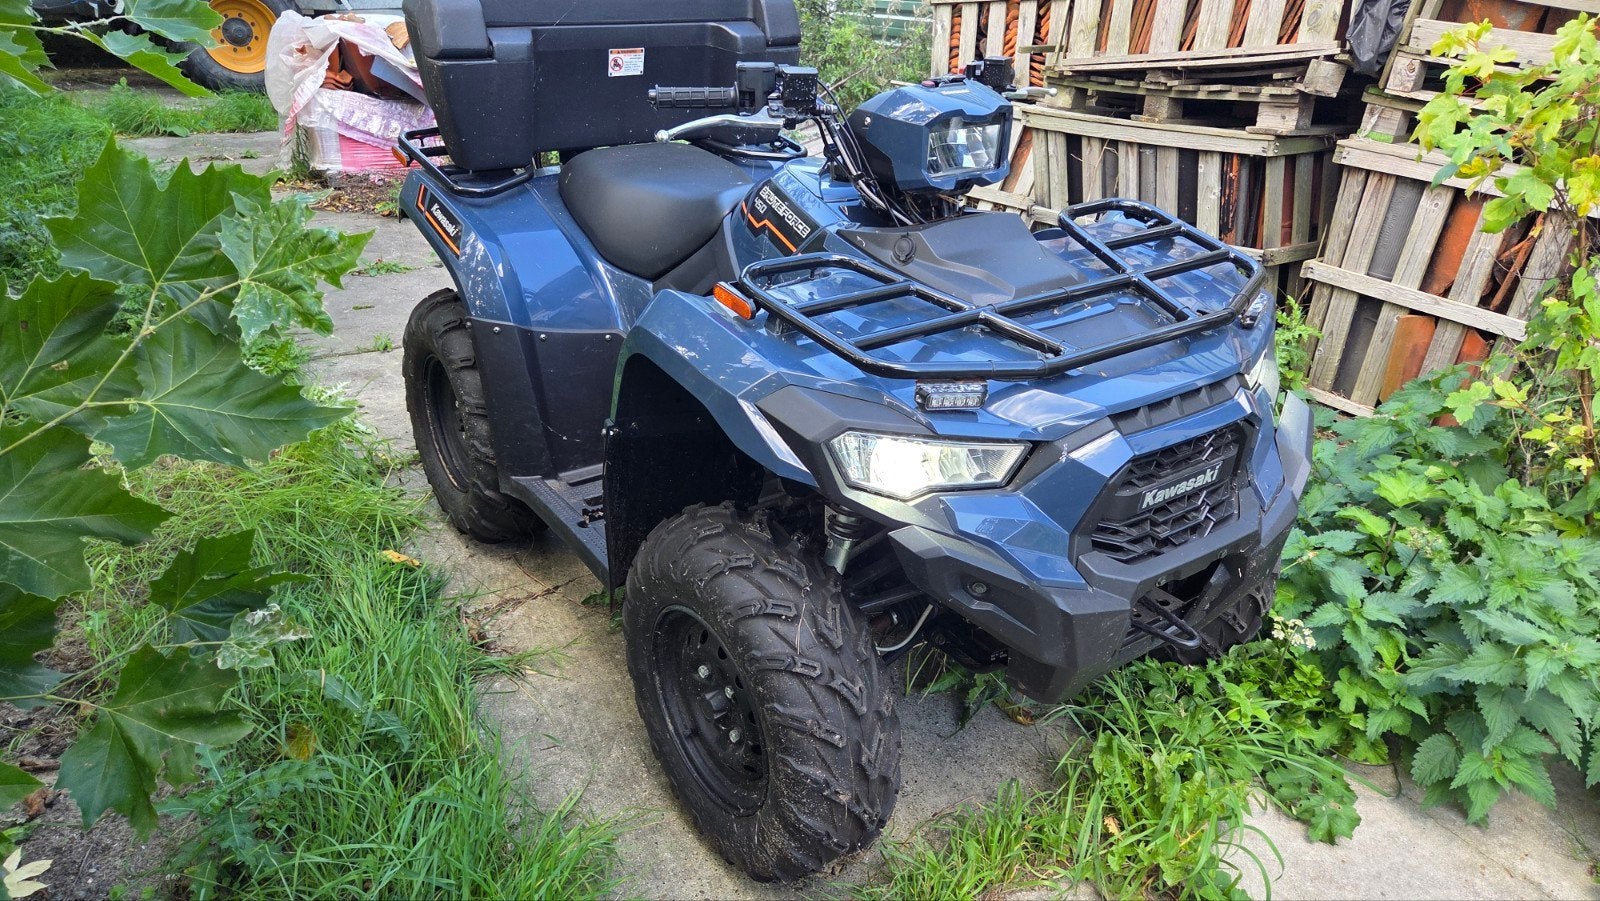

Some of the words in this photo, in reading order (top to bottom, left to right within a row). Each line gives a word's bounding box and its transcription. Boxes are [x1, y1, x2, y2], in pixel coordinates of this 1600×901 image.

[430, 203, 458, 236] Kawasaki
[754, 196, 767, 213] 450
[1142, 466, 1219, 508] Kawasaki
